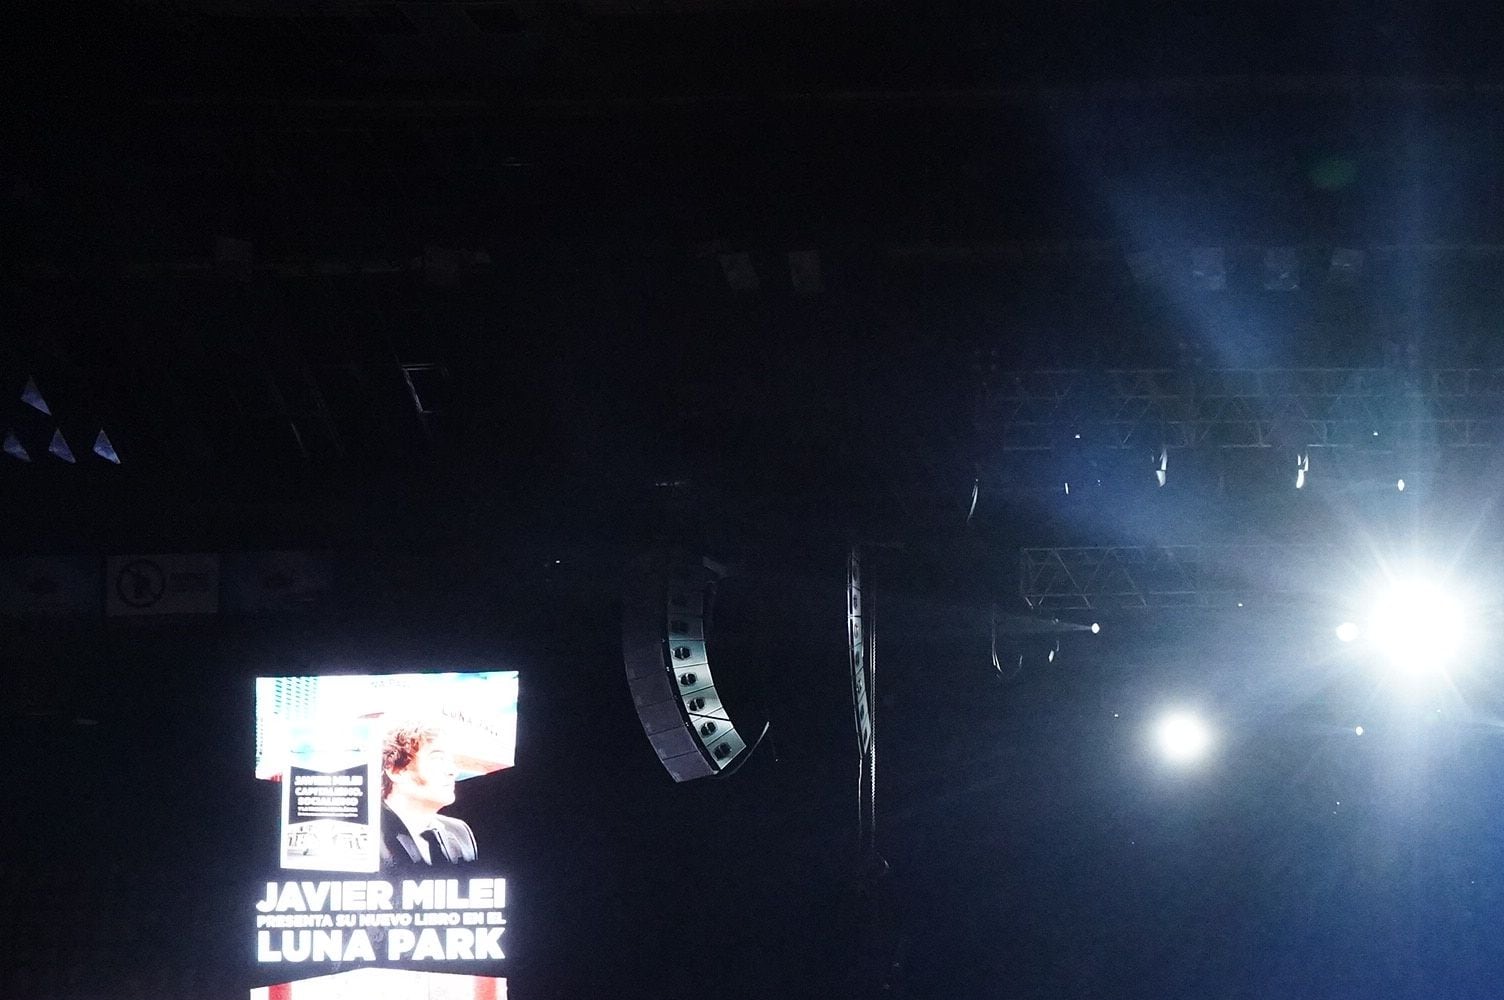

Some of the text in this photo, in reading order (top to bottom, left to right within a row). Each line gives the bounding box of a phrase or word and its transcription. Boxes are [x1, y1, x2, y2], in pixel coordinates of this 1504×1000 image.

[256, 878, 506, 912] JAVIER MILEI
[256, 914, 335, 928] PRESENTA
[335, 913, 357, 927] SU
[257, 927, 506, 963] LUNA PARK
